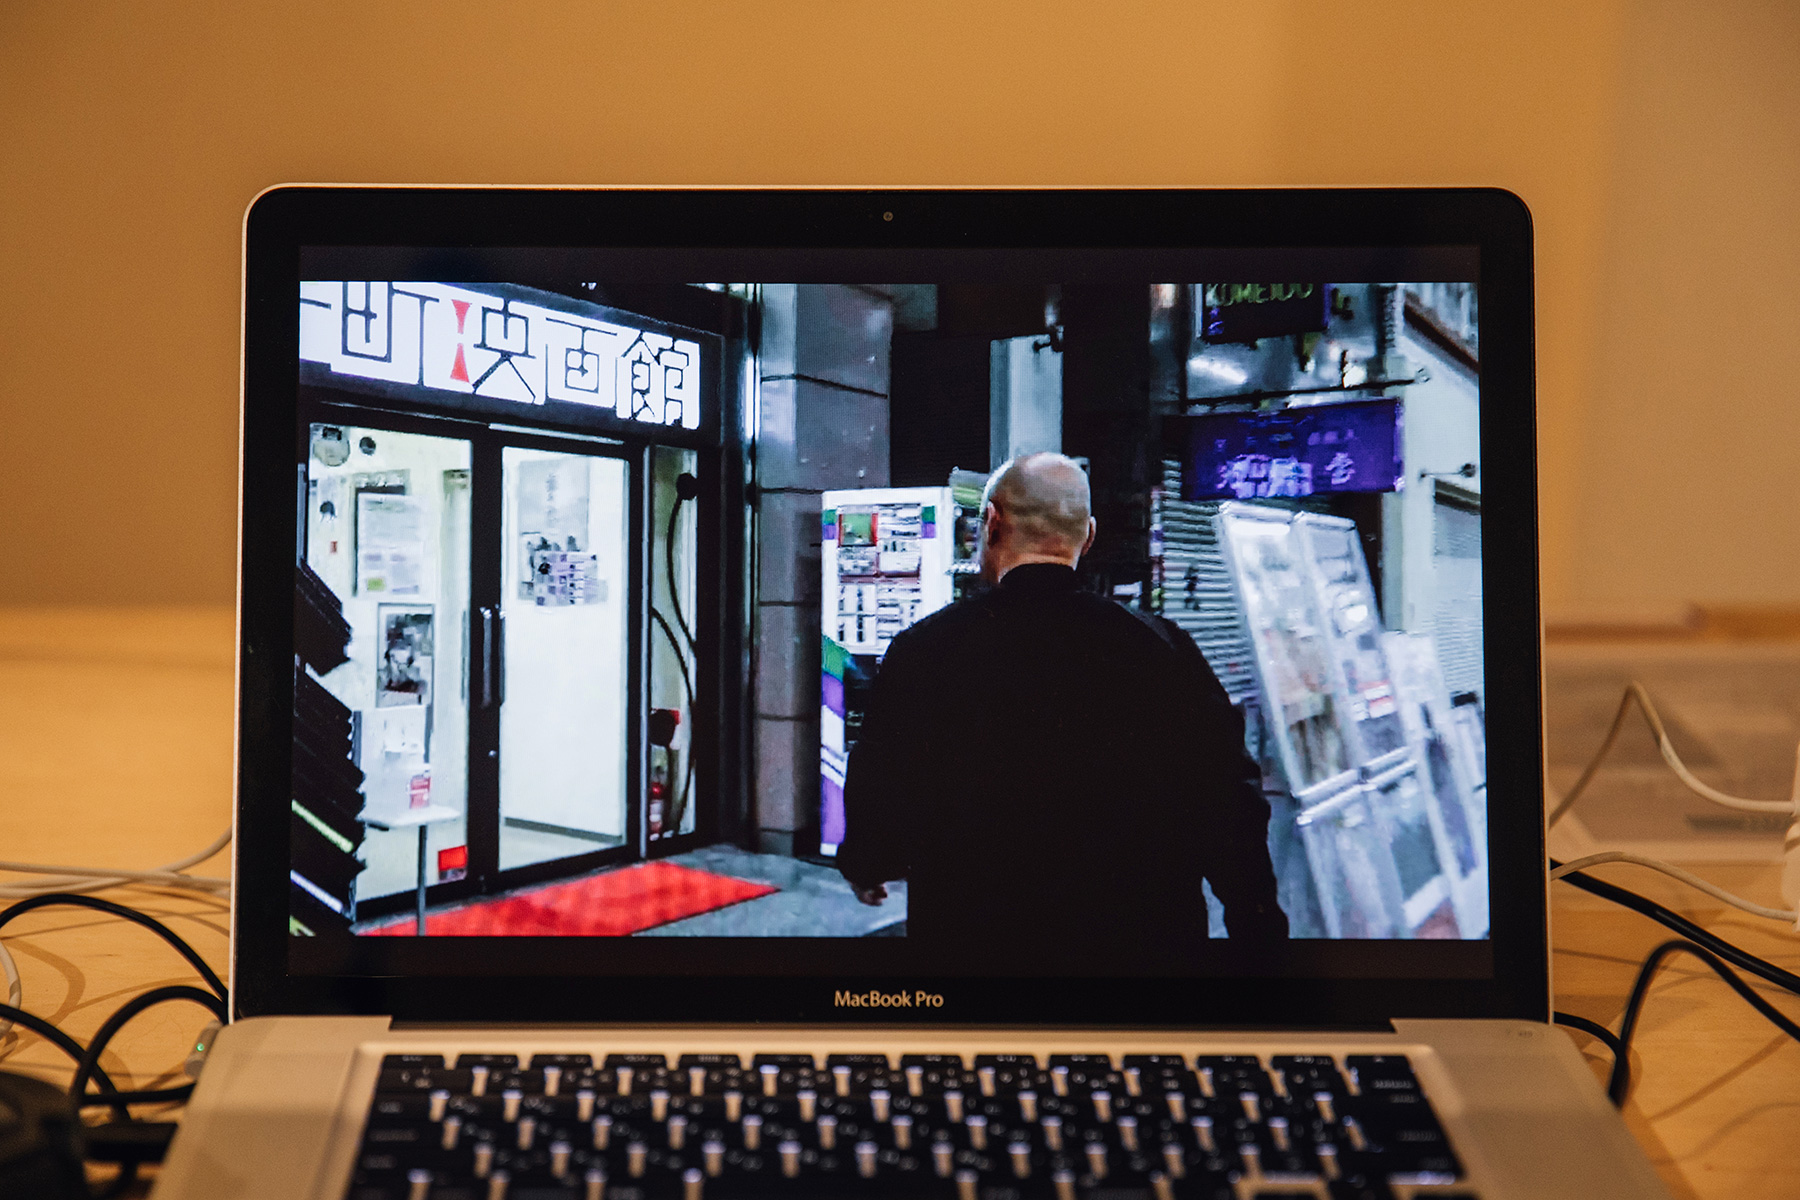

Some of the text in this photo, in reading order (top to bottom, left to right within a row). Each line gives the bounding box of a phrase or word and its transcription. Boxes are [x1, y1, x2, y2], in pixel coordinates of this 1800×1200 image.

[300, 281, 697, 428] 町映画館
[834, 989, 944, 1008] MacBook Pro
